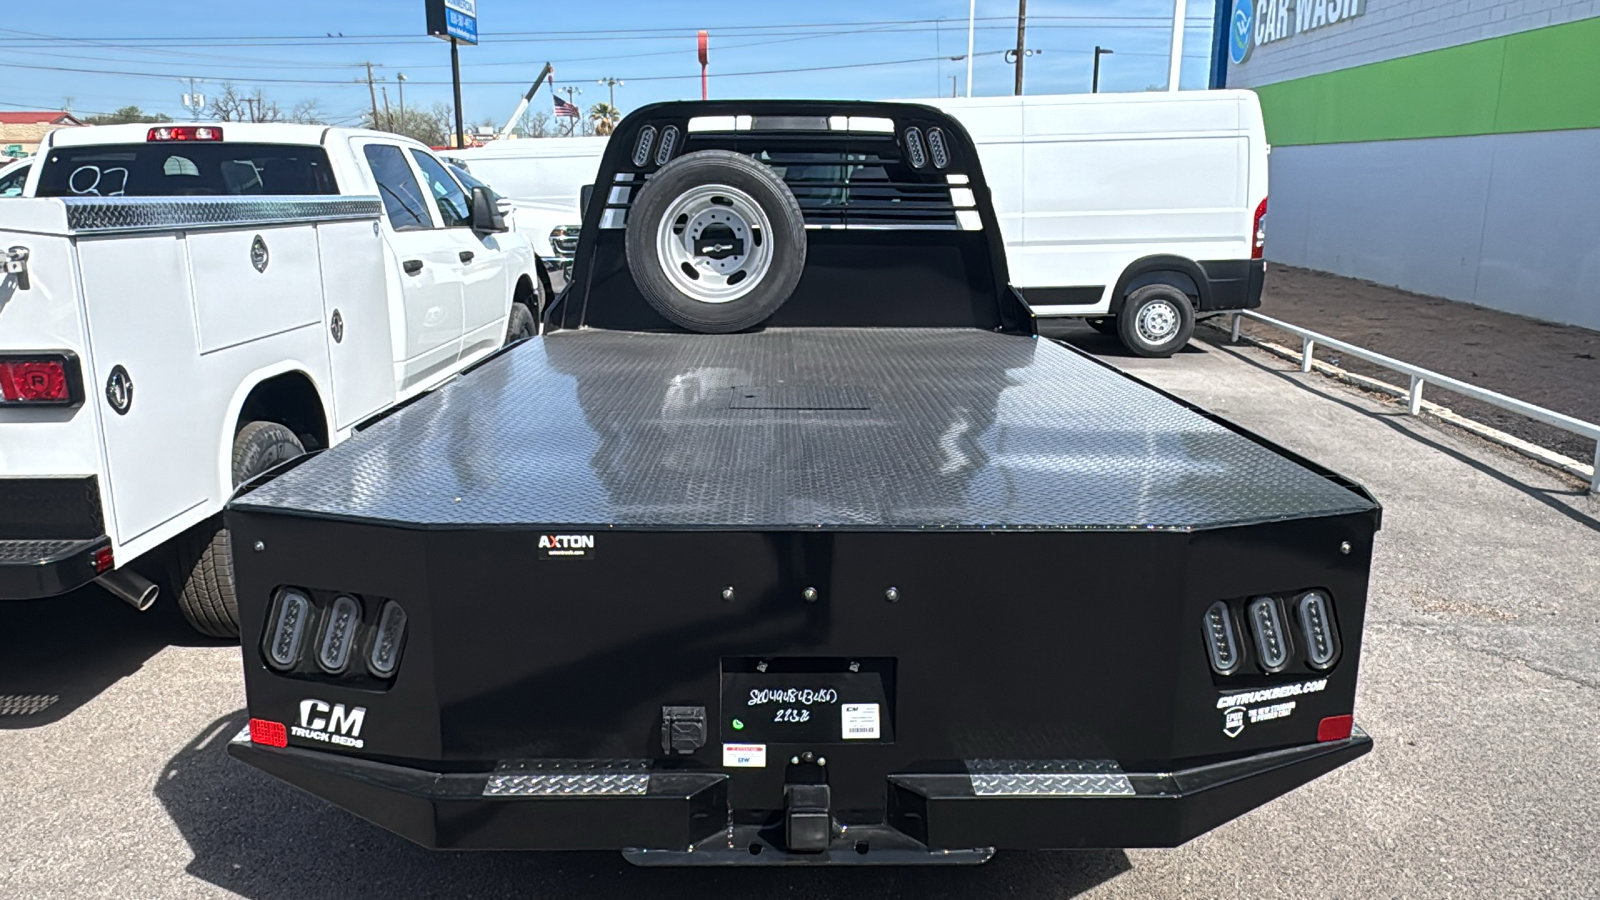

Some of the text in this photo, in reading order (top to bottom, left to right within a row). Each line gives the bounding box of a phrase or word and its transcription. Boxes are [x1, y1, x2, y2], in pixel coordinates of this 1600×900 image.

[1255, 0, 1288, 46] CAR
[538, 535, 594, 548] AXTON
[1216, 679, 1327, 708] CMTRUCKBEDS.COM
[300, 699, 366, 737] CM
[291, 726, 364, 748] TRUCK BEDS
